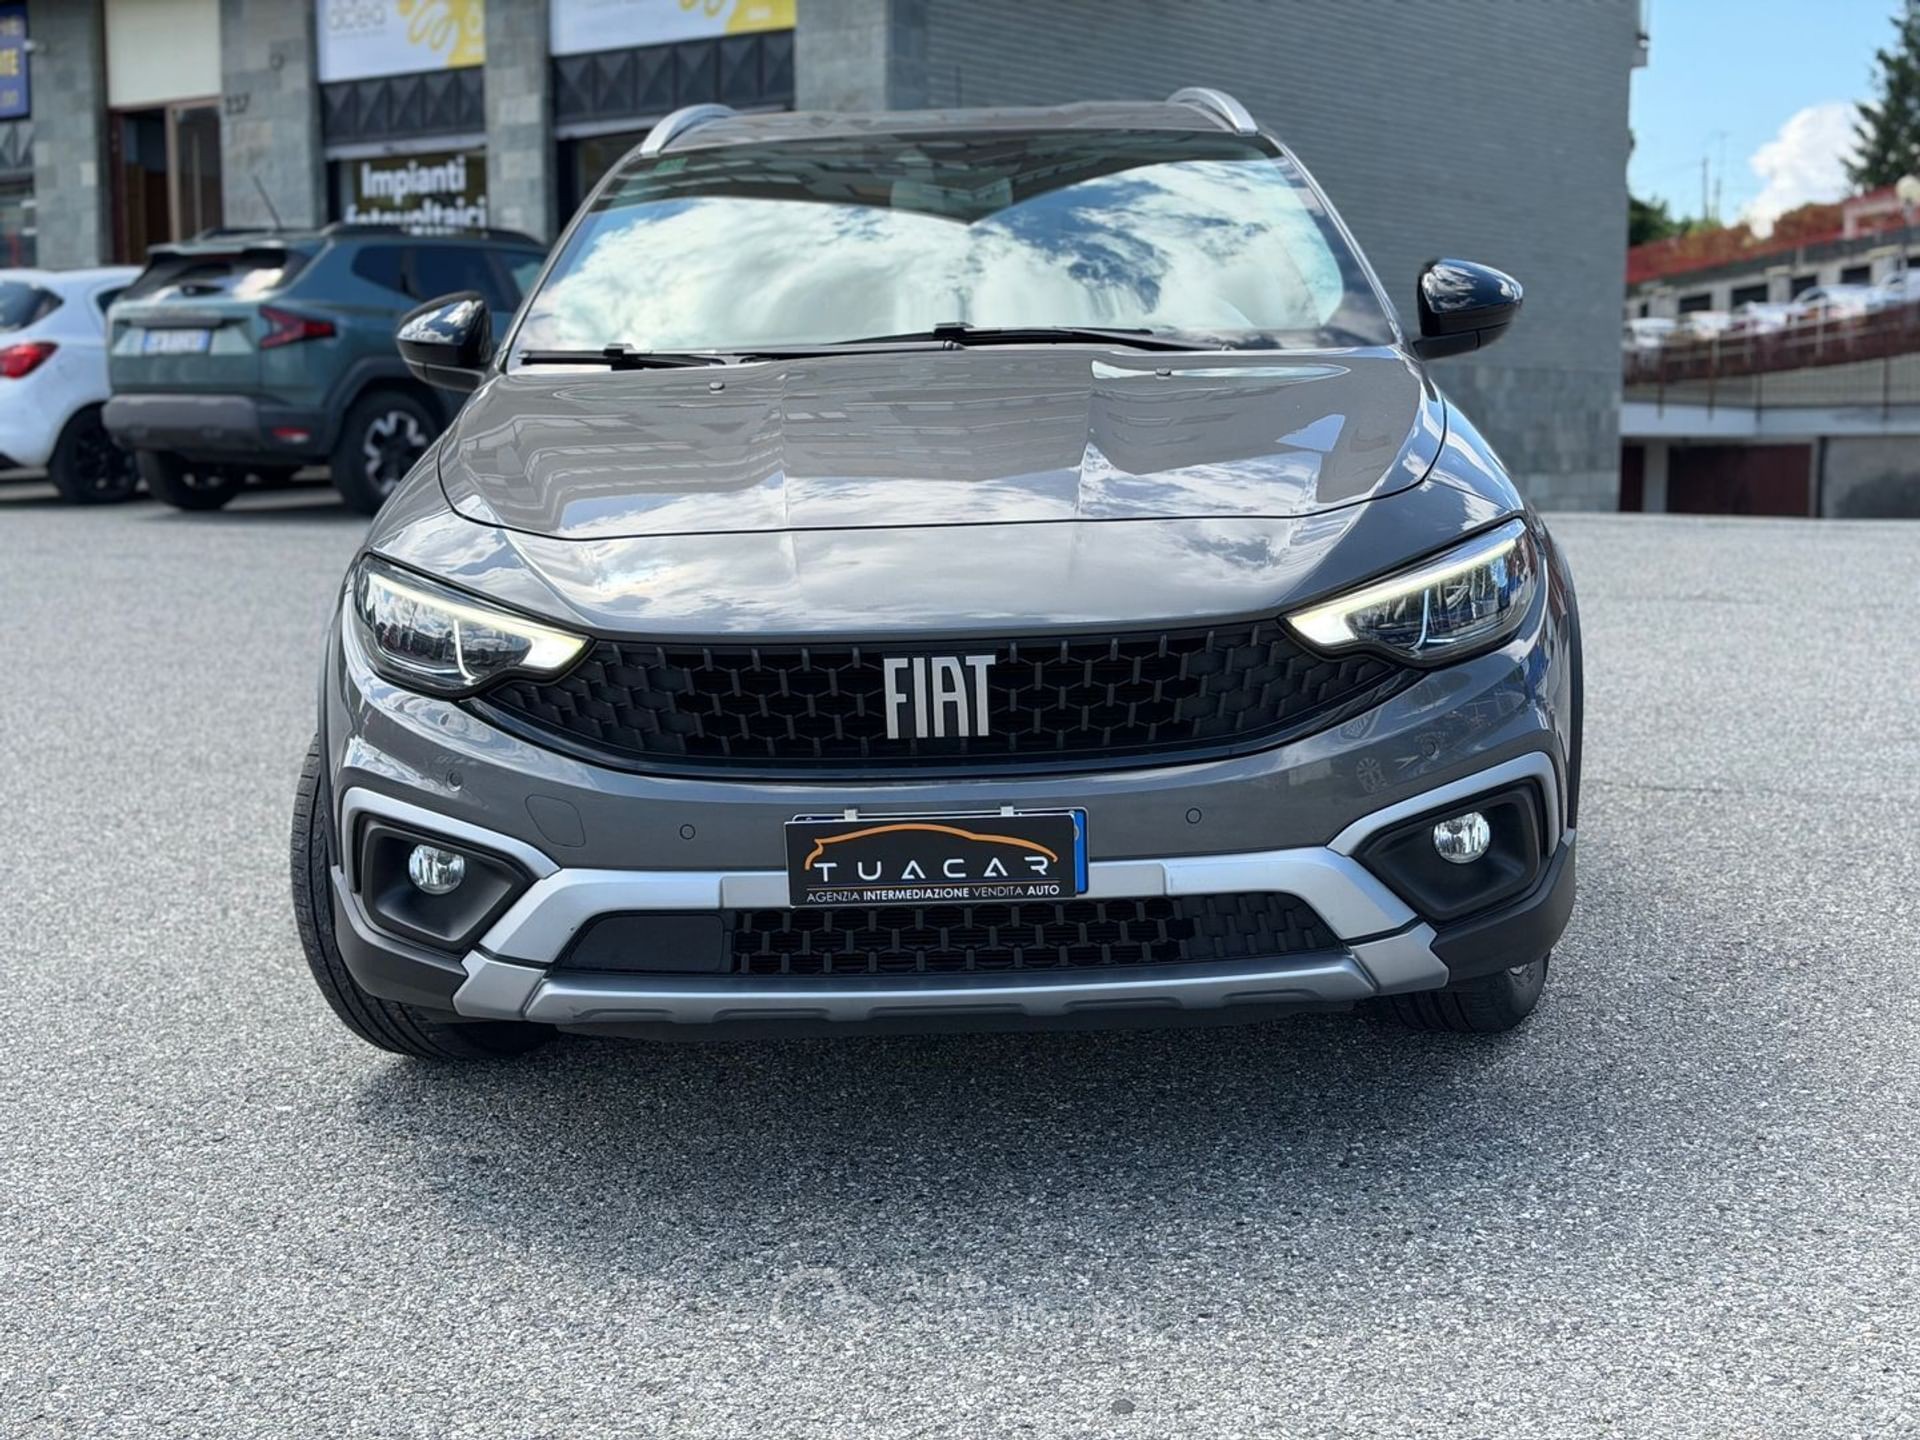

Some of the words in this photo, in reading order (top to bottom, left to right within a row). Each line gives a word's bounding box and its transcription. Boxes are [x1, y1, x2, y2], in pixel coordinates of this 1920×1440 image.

[361, 154, 466, 206] Impianti
[884, 655, 996, 739] FIAT
[813, 856, 1049, 883] TUACAR
[807, 888, 860, 903] AGENZIA
[863, 886, 970, 901] INTERMEDIAZIONE
[972, 885, 1025, 898] VENDITA
[1027, 884, 1060, 896] AUTO
